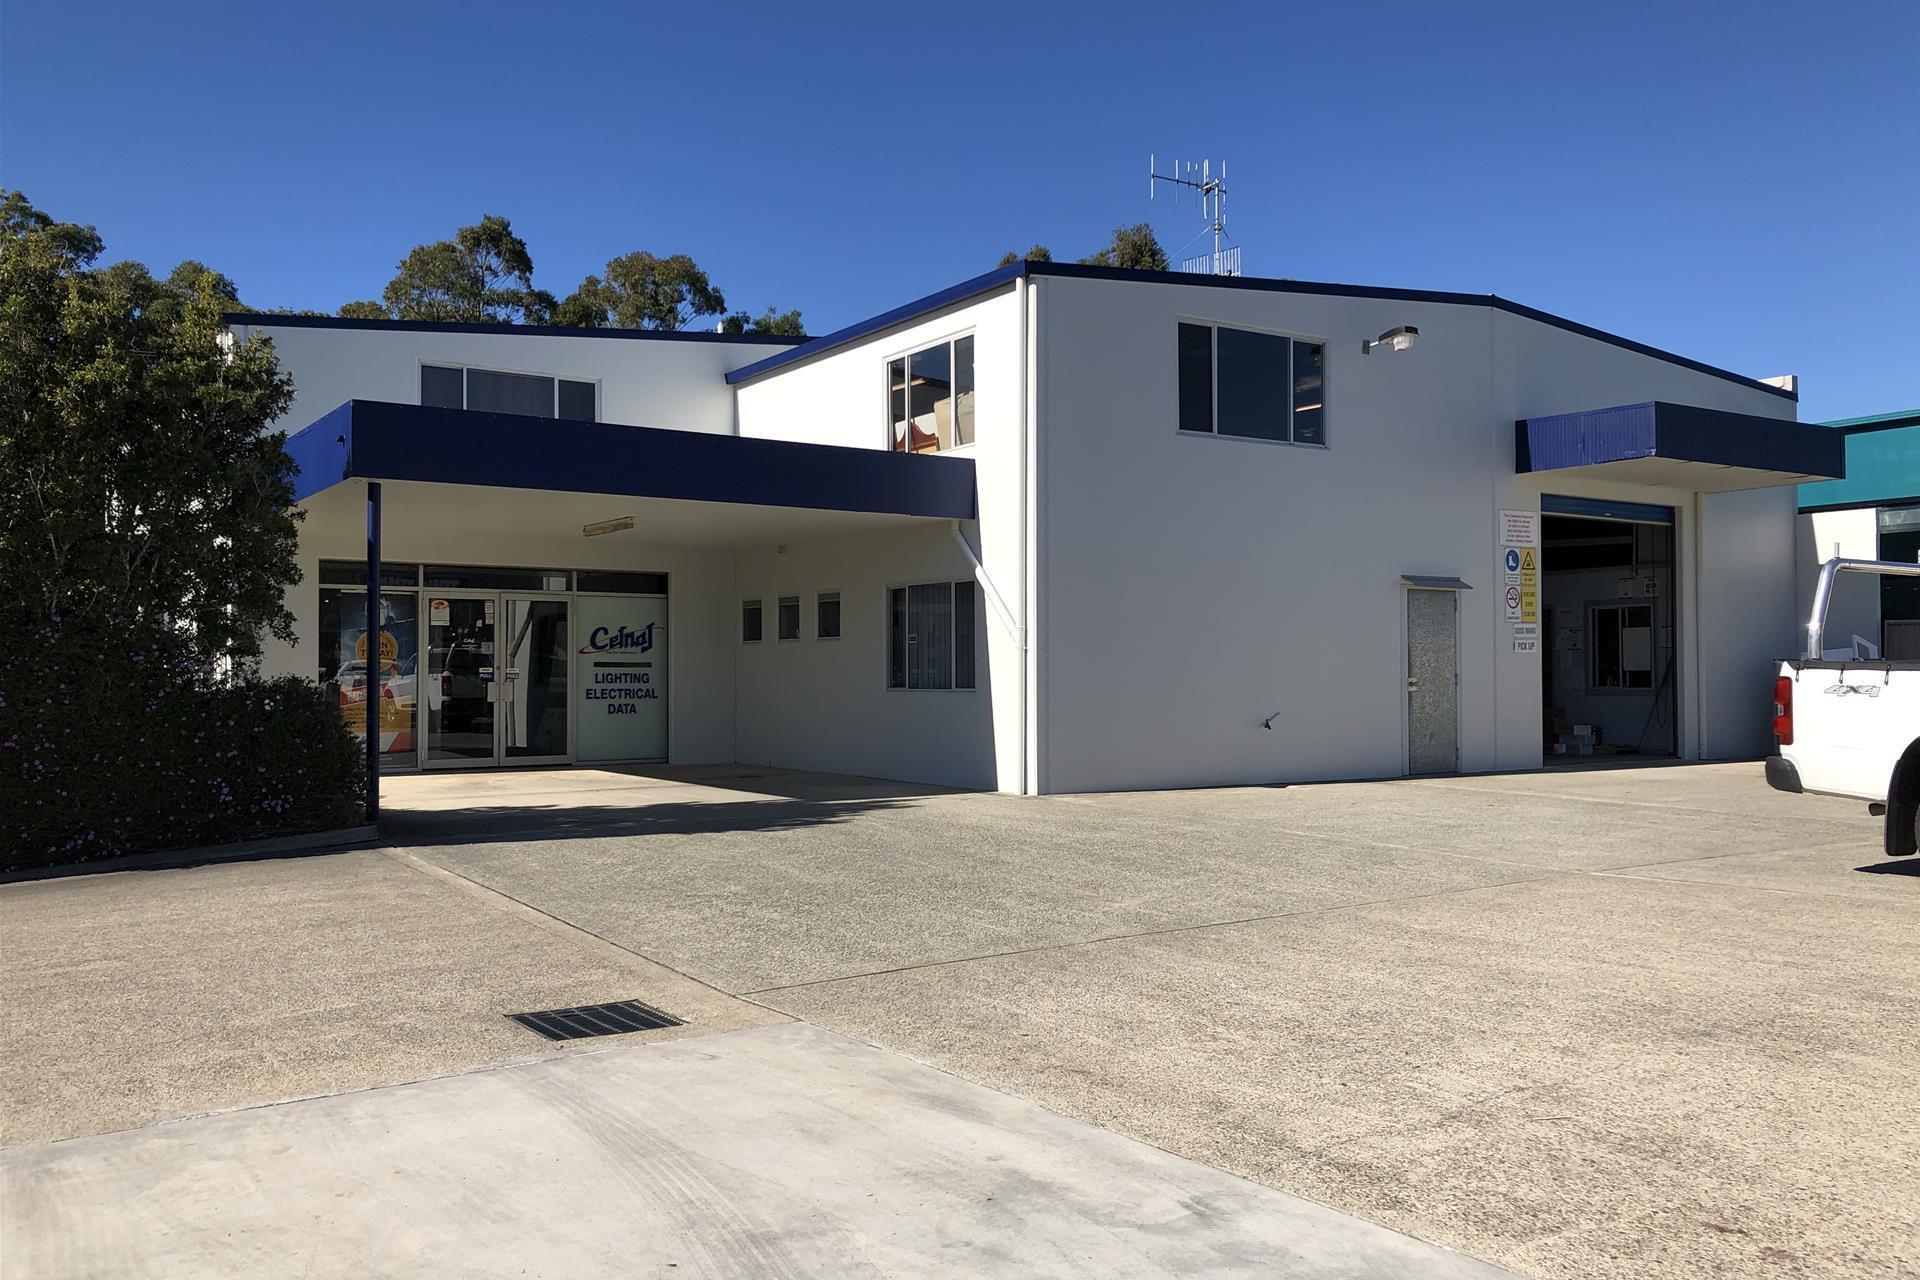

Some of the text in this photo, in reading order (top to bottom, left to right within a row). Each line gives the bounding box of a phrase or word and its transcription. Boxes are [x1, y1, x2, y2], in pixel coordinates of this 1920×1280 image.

[1517, 642, 1535, 651] PICK UP
[360, 649, 394, 657] TAY!
[595, 673, 650, 684] LIGHTING
[586, 688, 658, 699] ELECTRICAL
[608, 703, 637, 715] DATA
